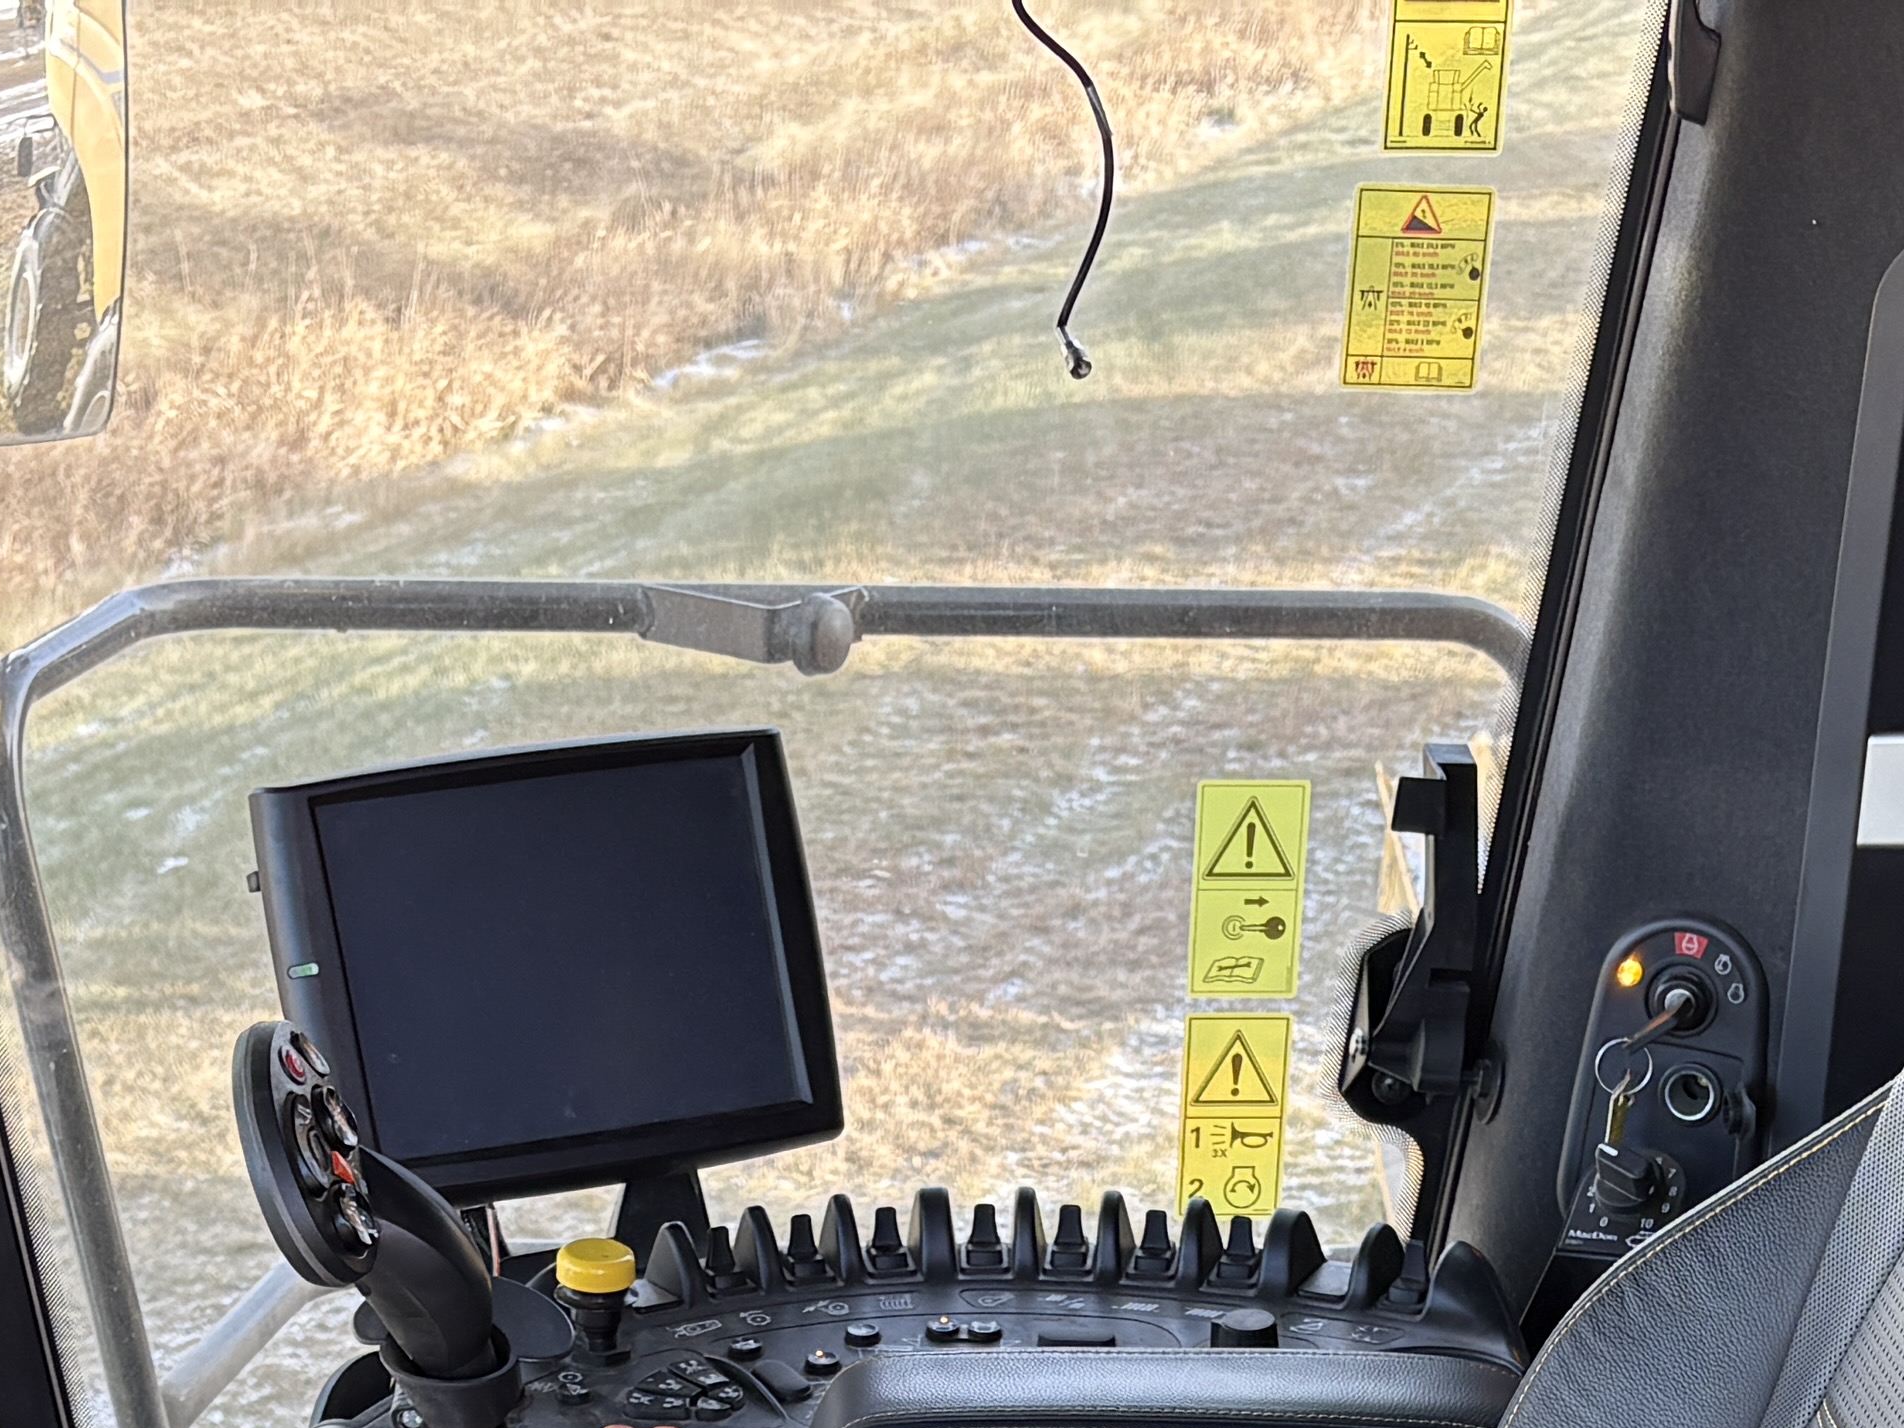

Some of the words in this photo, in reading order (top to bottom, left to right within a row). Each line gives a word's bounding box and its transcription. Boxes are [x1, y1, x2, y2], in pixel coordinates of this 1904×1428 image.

[1190, 1126, 1201, 1149] 1
[1187, 1178, 1205, 1199] 2
[1640, 1217, 1655, 1229] 10
[1567, 1229, 1618, 1241] MacDon
